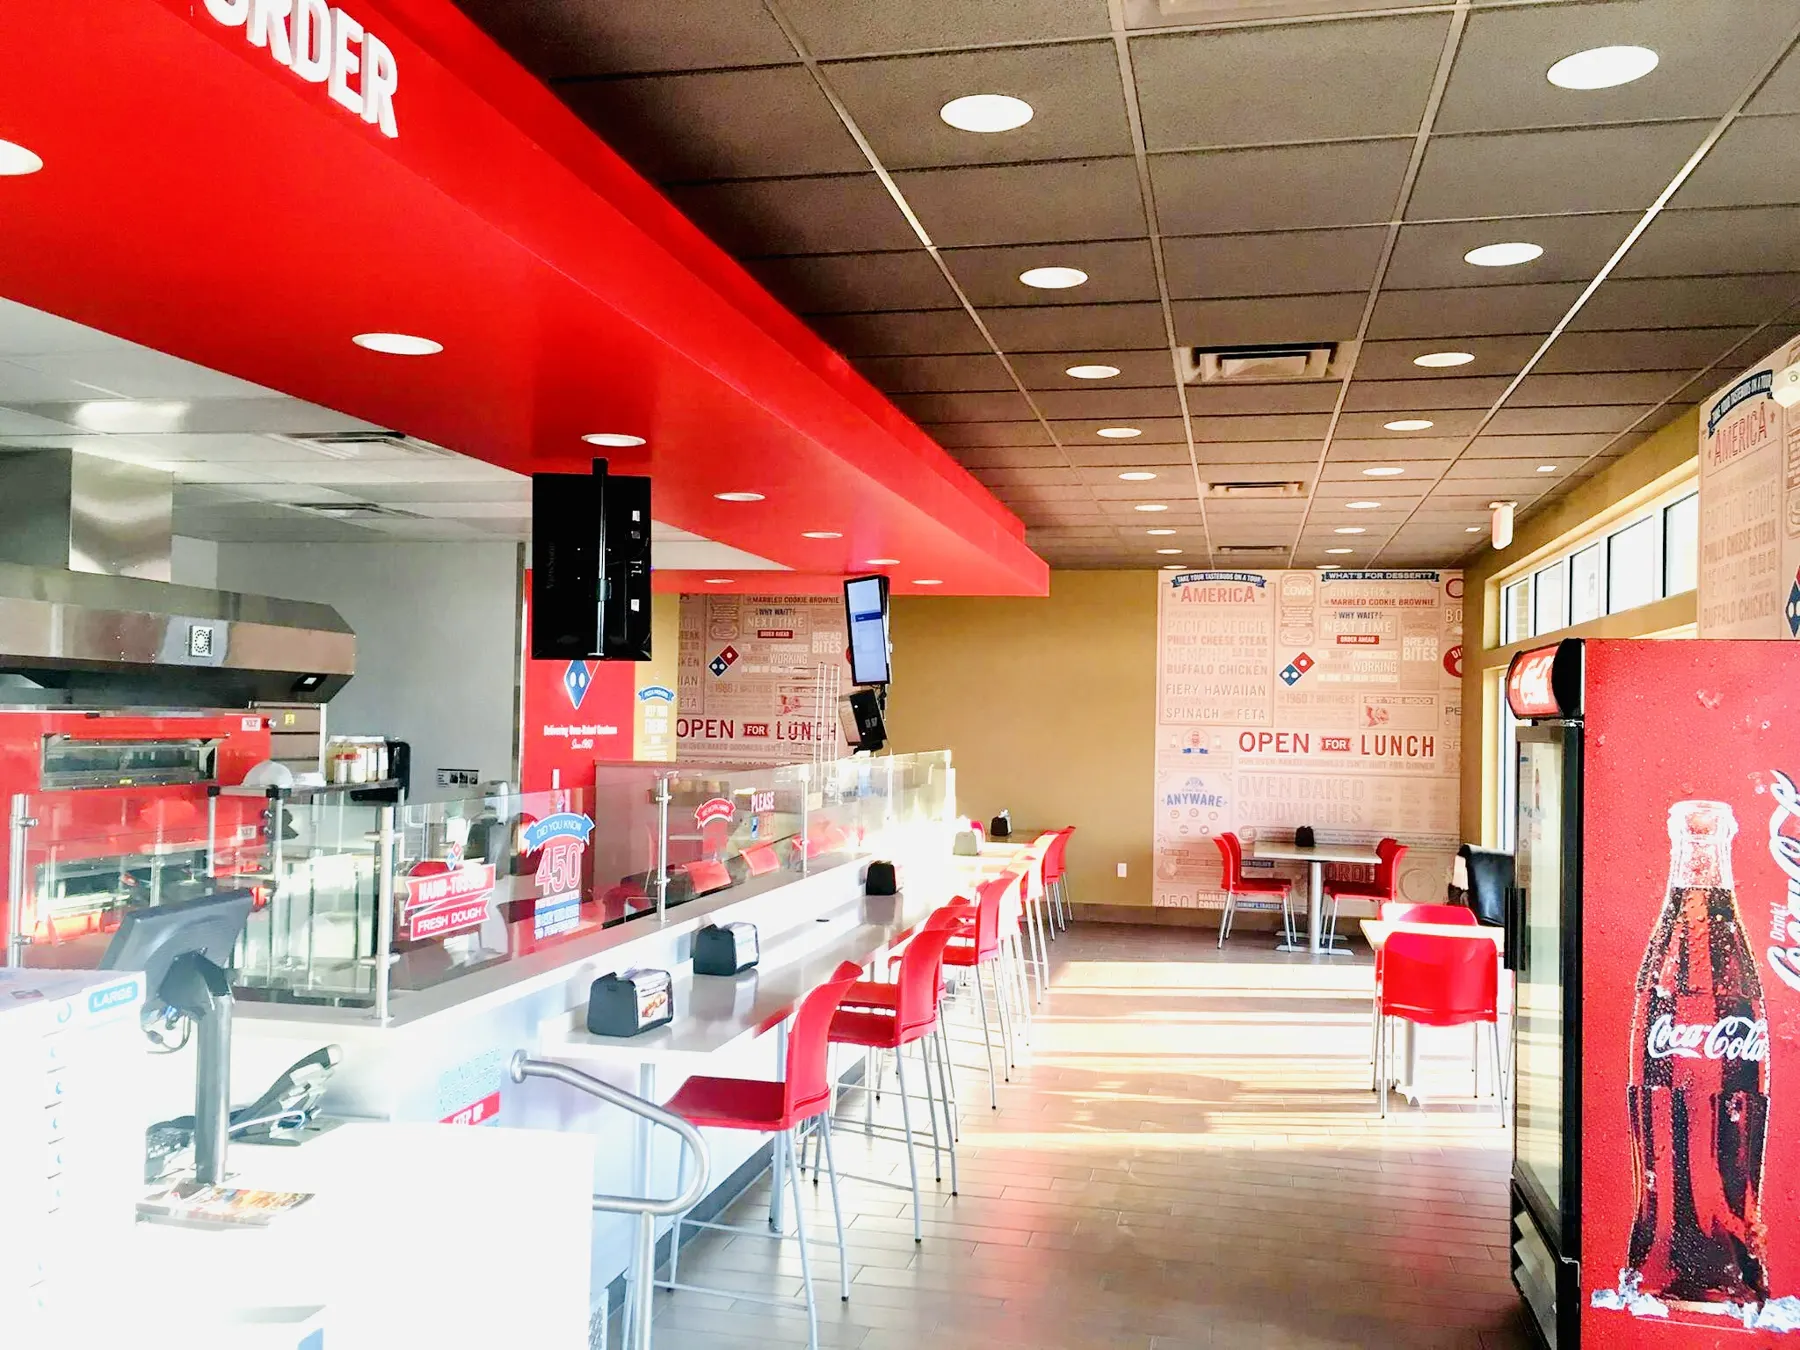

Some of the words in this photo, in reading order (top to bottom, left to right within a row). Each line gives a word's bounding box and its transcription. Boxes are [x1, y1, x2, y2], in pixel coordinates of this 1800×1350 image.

[203, 0, 399, 139] RDER
[1713, 401, 1767, 466] AMERICA
[1328, 572, 1363, 580] WHAT'S
[1385, 572, 1433, 580] DESSERT?
[1181, 585, 1256, 603] AMERICA
[1330, 598, 1367, 606] MARBLED
[1368, 598, 1397, 606] COOKIE
[1398, 598, 1435, 606] BROWNIE
[1338, 611, 1355, 620] WHY
[1356, 611, 1380, 620] WAIT?
[1324, 620, 1358, 633] NEXT
[1361, 621, 1392, 634] TIME
[812, 631, 842, 641] BREAD
[1200, 635, 1236, 646] CHEESE
[1238, 635, 1269, 647] STEAK
[1402, 637, 1439, 648] BREAD
[812, 640, 842, 654] BITES
[1402, 647, 1439, 662] BITES
[769, 653, 808, 665] WORKING
[1166, 663, 1215, 675] BUFFALO
[1218, 664, 1269, 676] CHICKEN
[1352, 660, 1397, 674] WORKING
[1165, 683, 1200, 696] FIERY
[1204, 684, 1267, 697] HAWAIIAN
[1165, 706, 1220, 719] SPINACH
[1237, 707, 1267, 721] FETA
[677, 718, 734, 739] OPEN
[746, 725, 765, 736] FOR
[776, 720, 838, 742] LUNCH
[1238, 730, 1310, 754] OPEN
[1324, 738, 1347, 750] FOR
[1360, 734, 1435, 758] LUNCH
[1237, 775, 1292, 799] OVEN
[1298, 777, 1365, 801] BAKED
[751, 791, 776, 814] PLEASE
[1166, 793, 1223, 808] ANYWARE
[1237, 801, 1363, 825] SANDWICHES
[536, 826, 549, 840] DID
[548, 821, 563, 832] YOU
[564, 819, 583, 832] KNOW
[417, 914, 450, 933] FRESH
[450, 906, 483, 925] DOUGH
[92, 985, 133, 1009] LARGE
[1647, 1014, 1771, 1062] Coca-Cola
